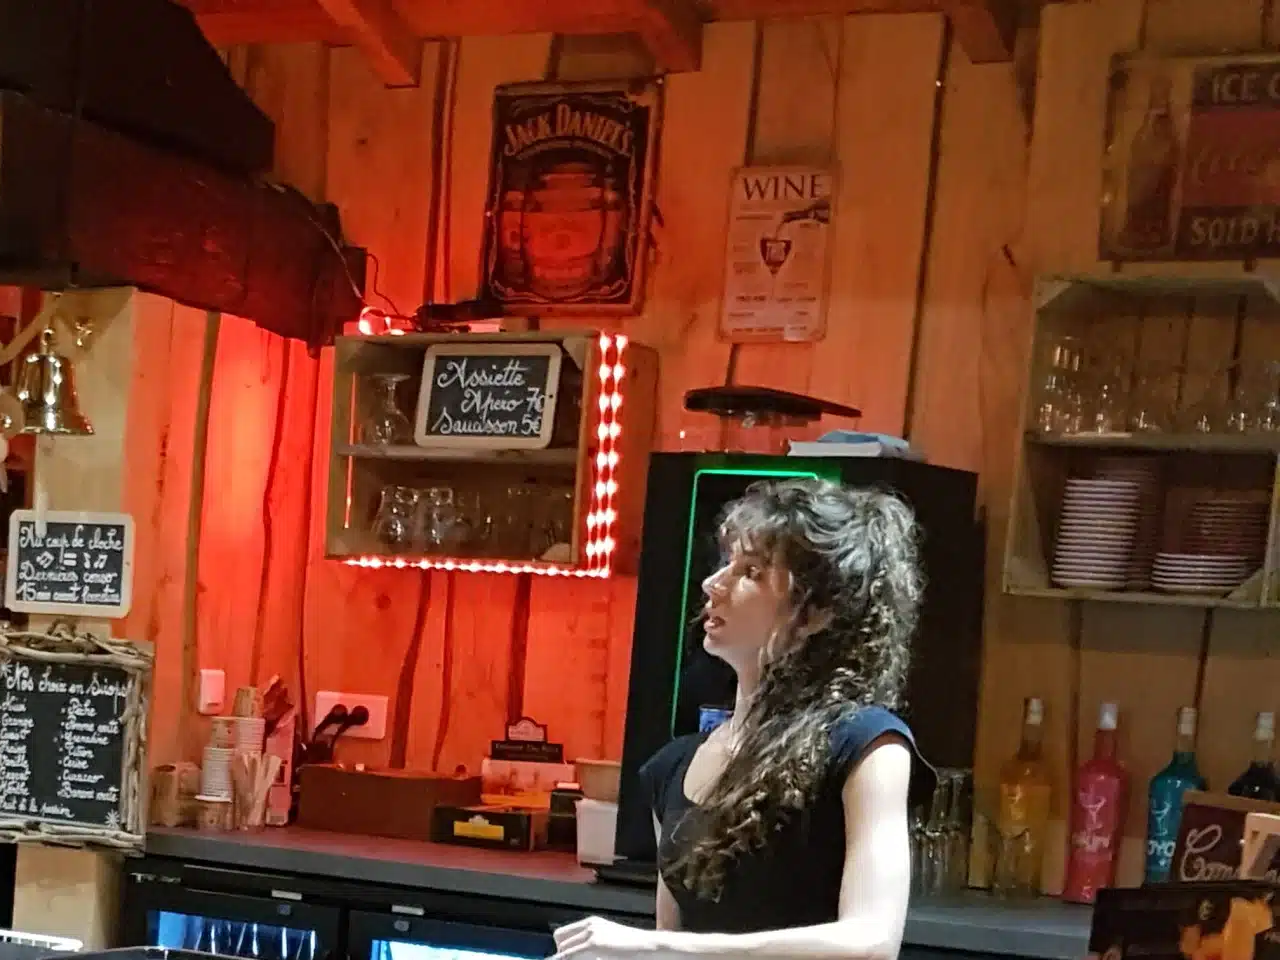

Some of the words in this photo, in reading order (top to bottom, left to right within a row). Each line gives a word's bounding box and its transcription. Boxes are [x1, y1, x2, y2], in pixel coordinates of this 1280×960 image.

[1212, 72, 1260, 103] ICE
[504, 112, 551, 157] JACK
[742, 174, 822, 200] WINE
[1191, 214, 1258, 247] SOLD
[437, 358, 528, 388] Assiette
[71, 524, 85, 548] de
[6, 661, 34, 691] Nos
[68, 684, 84, 694] en
